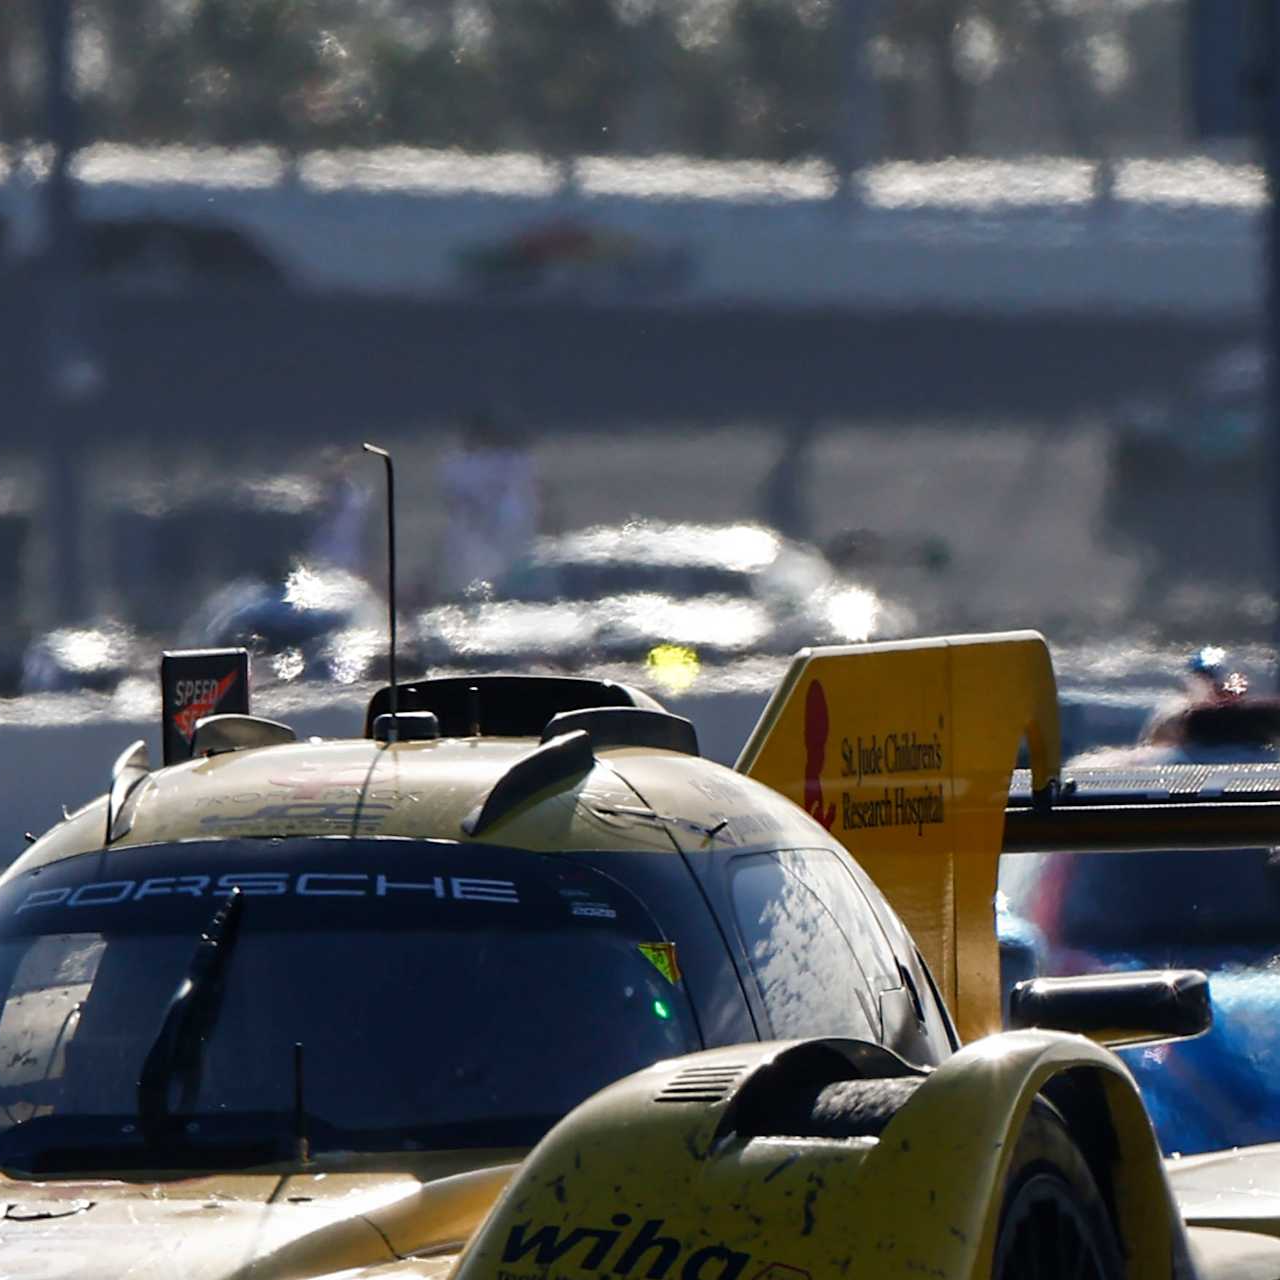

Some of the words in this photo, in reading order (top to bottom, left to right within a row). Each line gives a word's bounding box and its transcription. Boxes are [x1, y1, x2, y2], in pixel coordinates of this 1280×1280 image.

[175, 679, 218, 706] SPEED
[857, 735, 882, 787] Jude
[885, 731, 942, 773] Children's
[842, 786, 892, 831] Research
[895, 783, 944, 837] Hospital
[16, 873, 519, 913] PORSCHE
